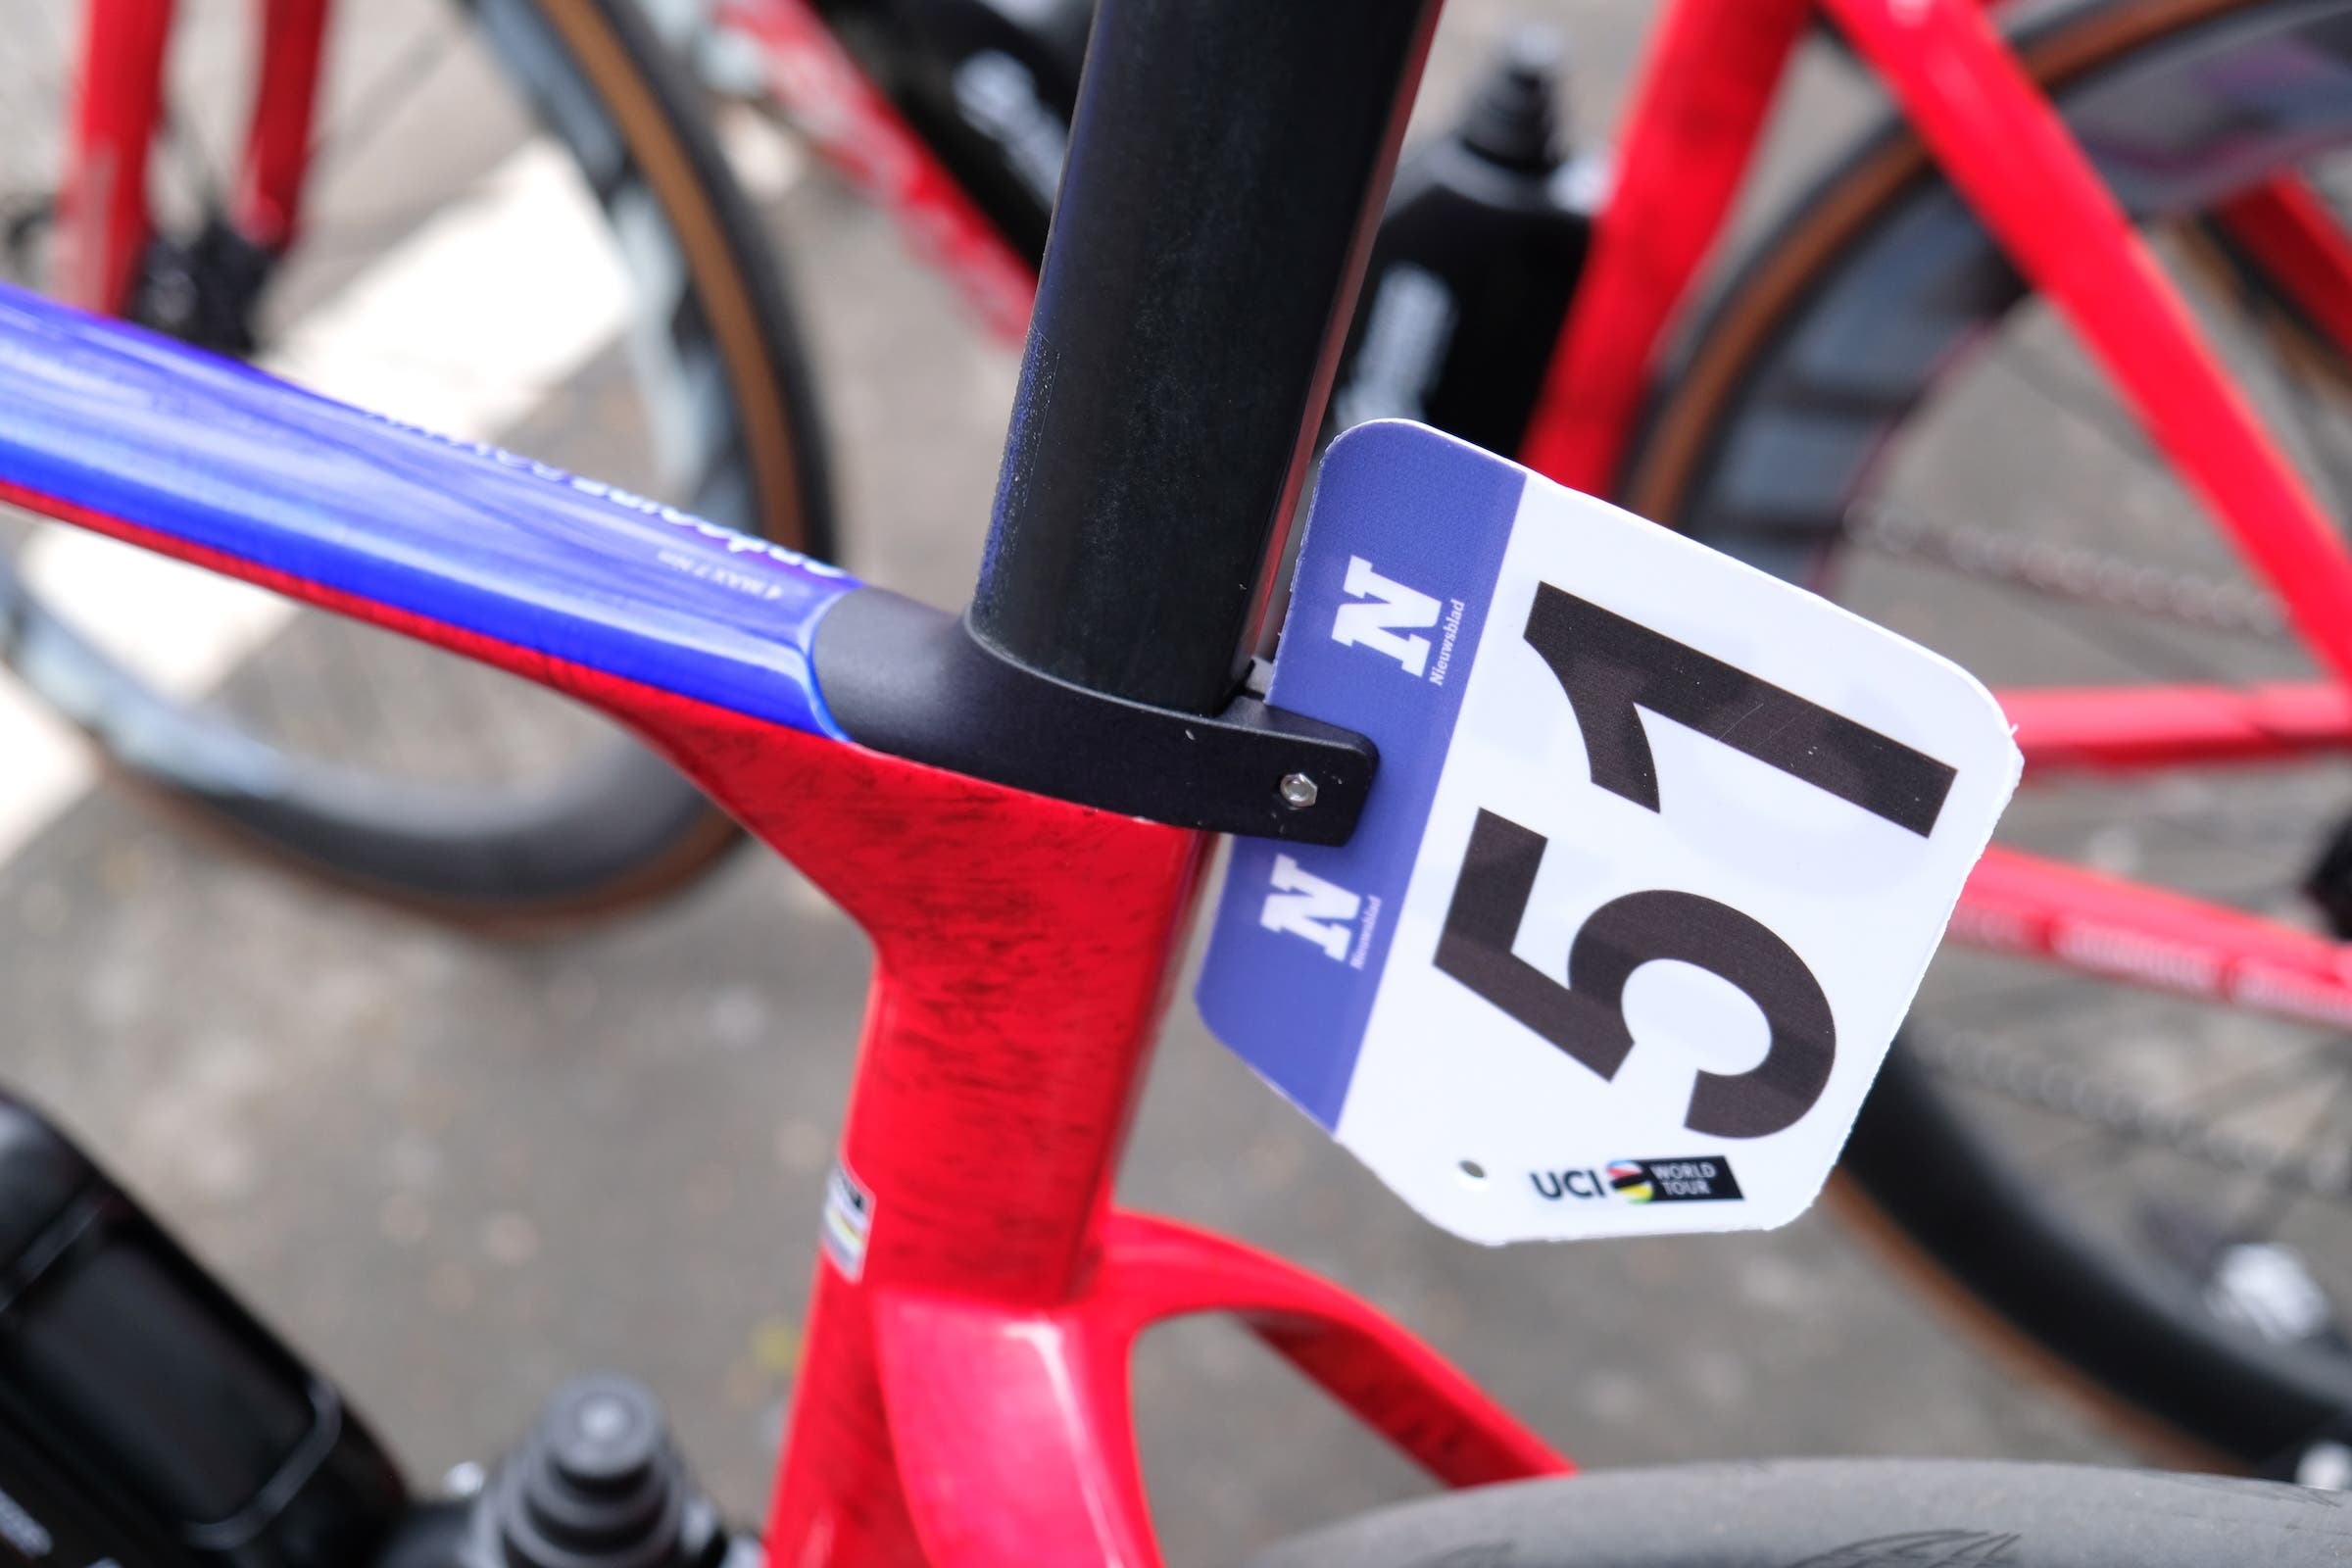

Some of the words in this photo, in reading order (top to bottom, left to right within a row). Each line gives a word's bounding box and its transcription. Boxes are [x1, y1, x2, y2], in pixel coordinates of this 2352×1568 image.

[1331, 555, 1443, 678] N
[1429, 598, 1465, 686] Nieuwsblad
[1432, 580, 1958, 1140] 51
[1260, 854, 1361, 962] N
[1530, 1169, 1606, 1201] UCI
[1650, 1161, 1716, 1181] WORLD
[1661, 1180, 1711, 1196] TOUR
